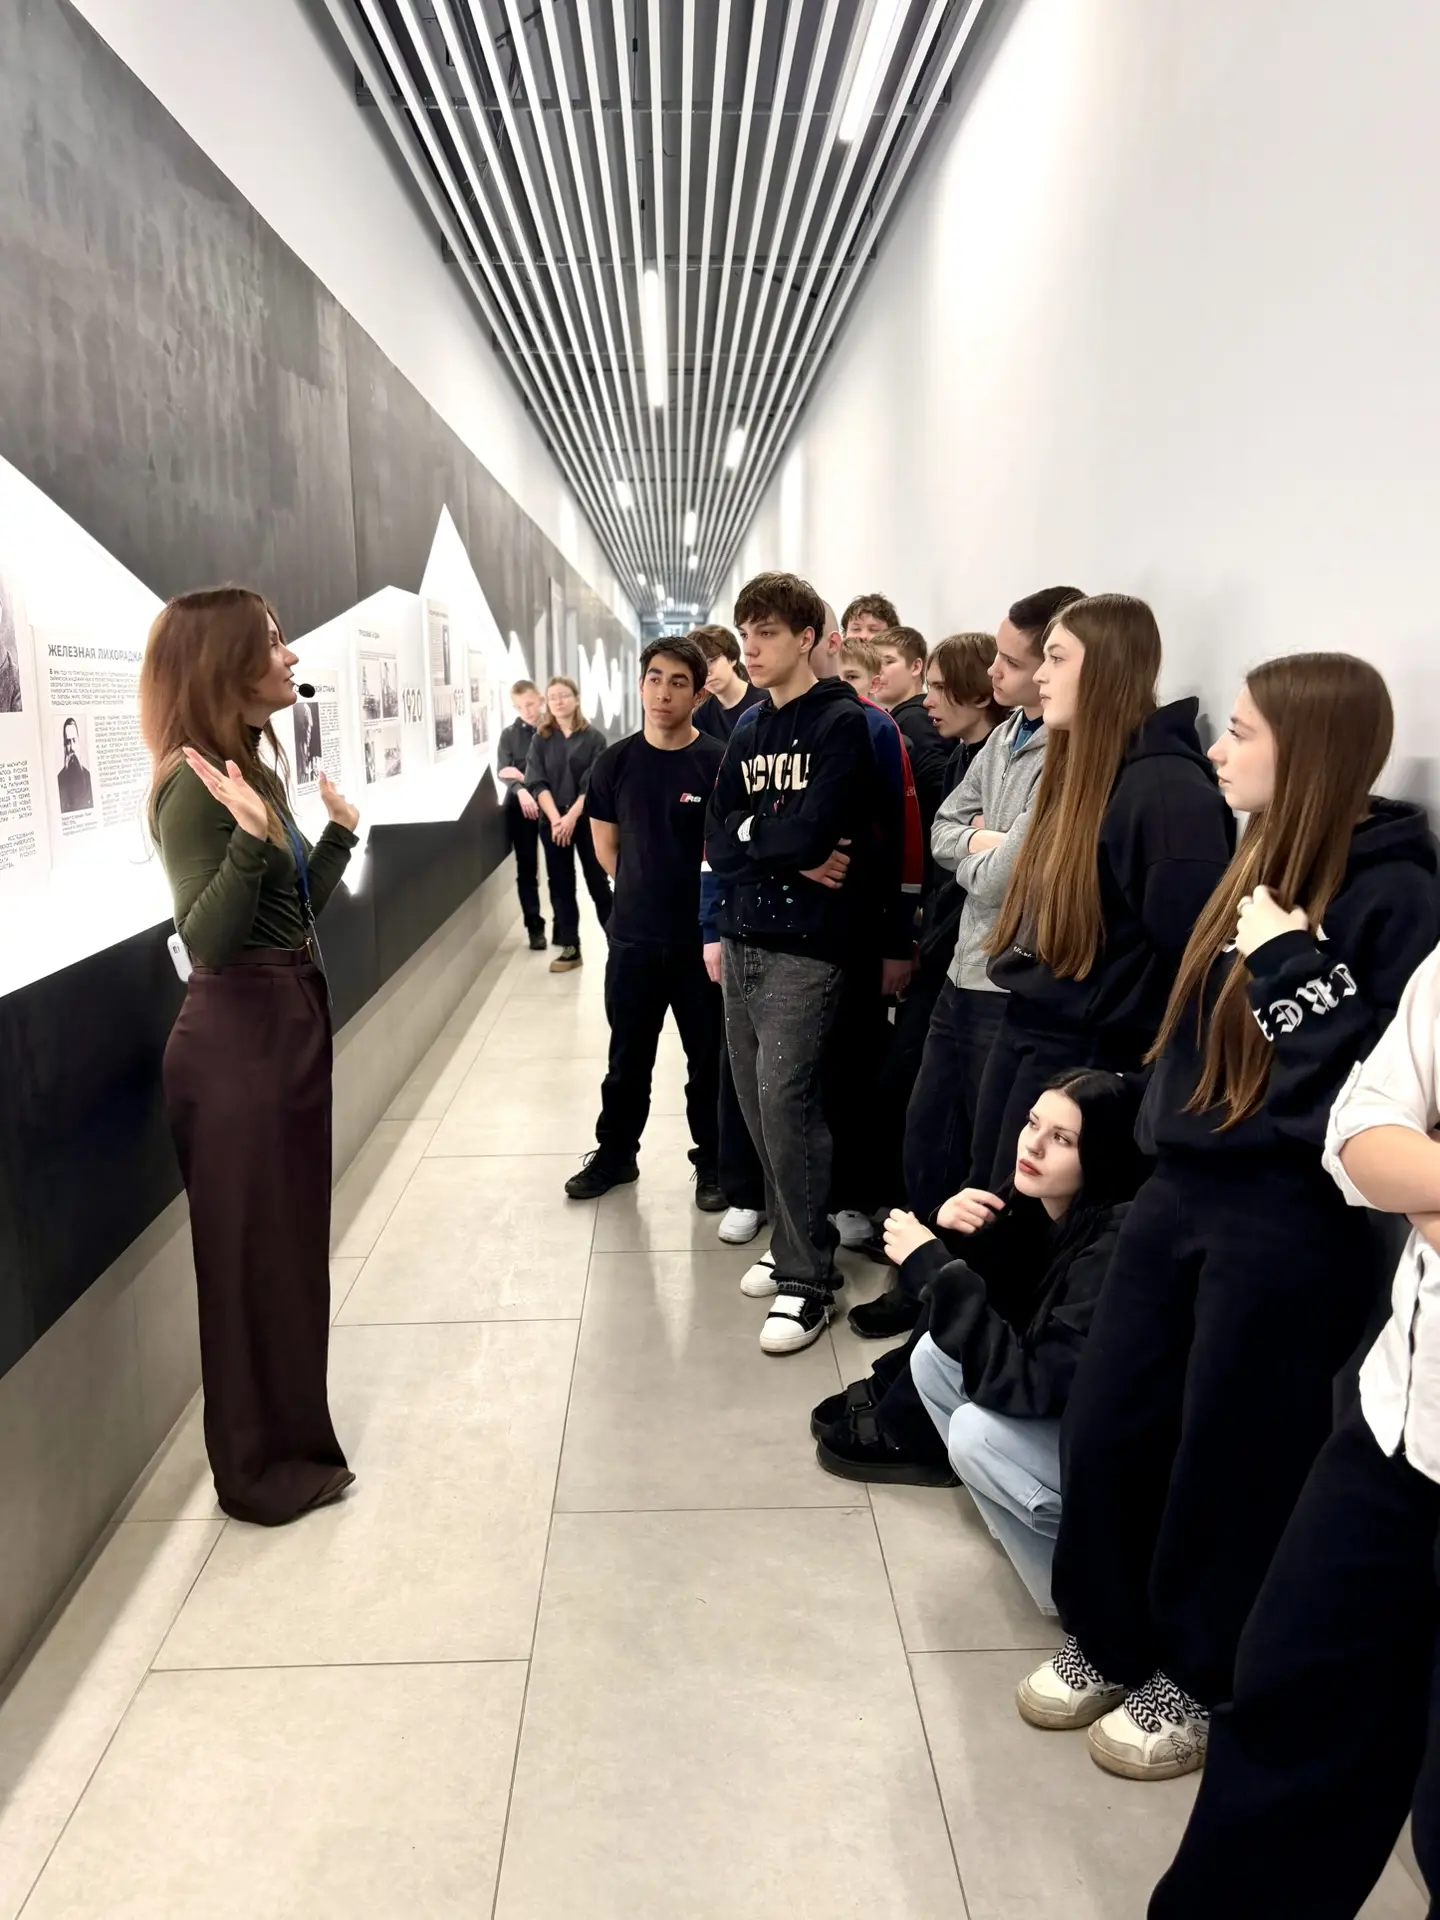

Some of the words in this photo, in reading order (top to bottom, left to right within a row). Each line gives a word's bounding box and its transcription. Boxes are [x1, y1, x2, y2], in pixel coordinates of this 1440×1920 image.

[48, 644, 96, 659] ЖЕЛЕЗНАЯ
[98, 648, 143, 663] ЛИХОРАДКА
[402, 688, 422, 724] 1920
